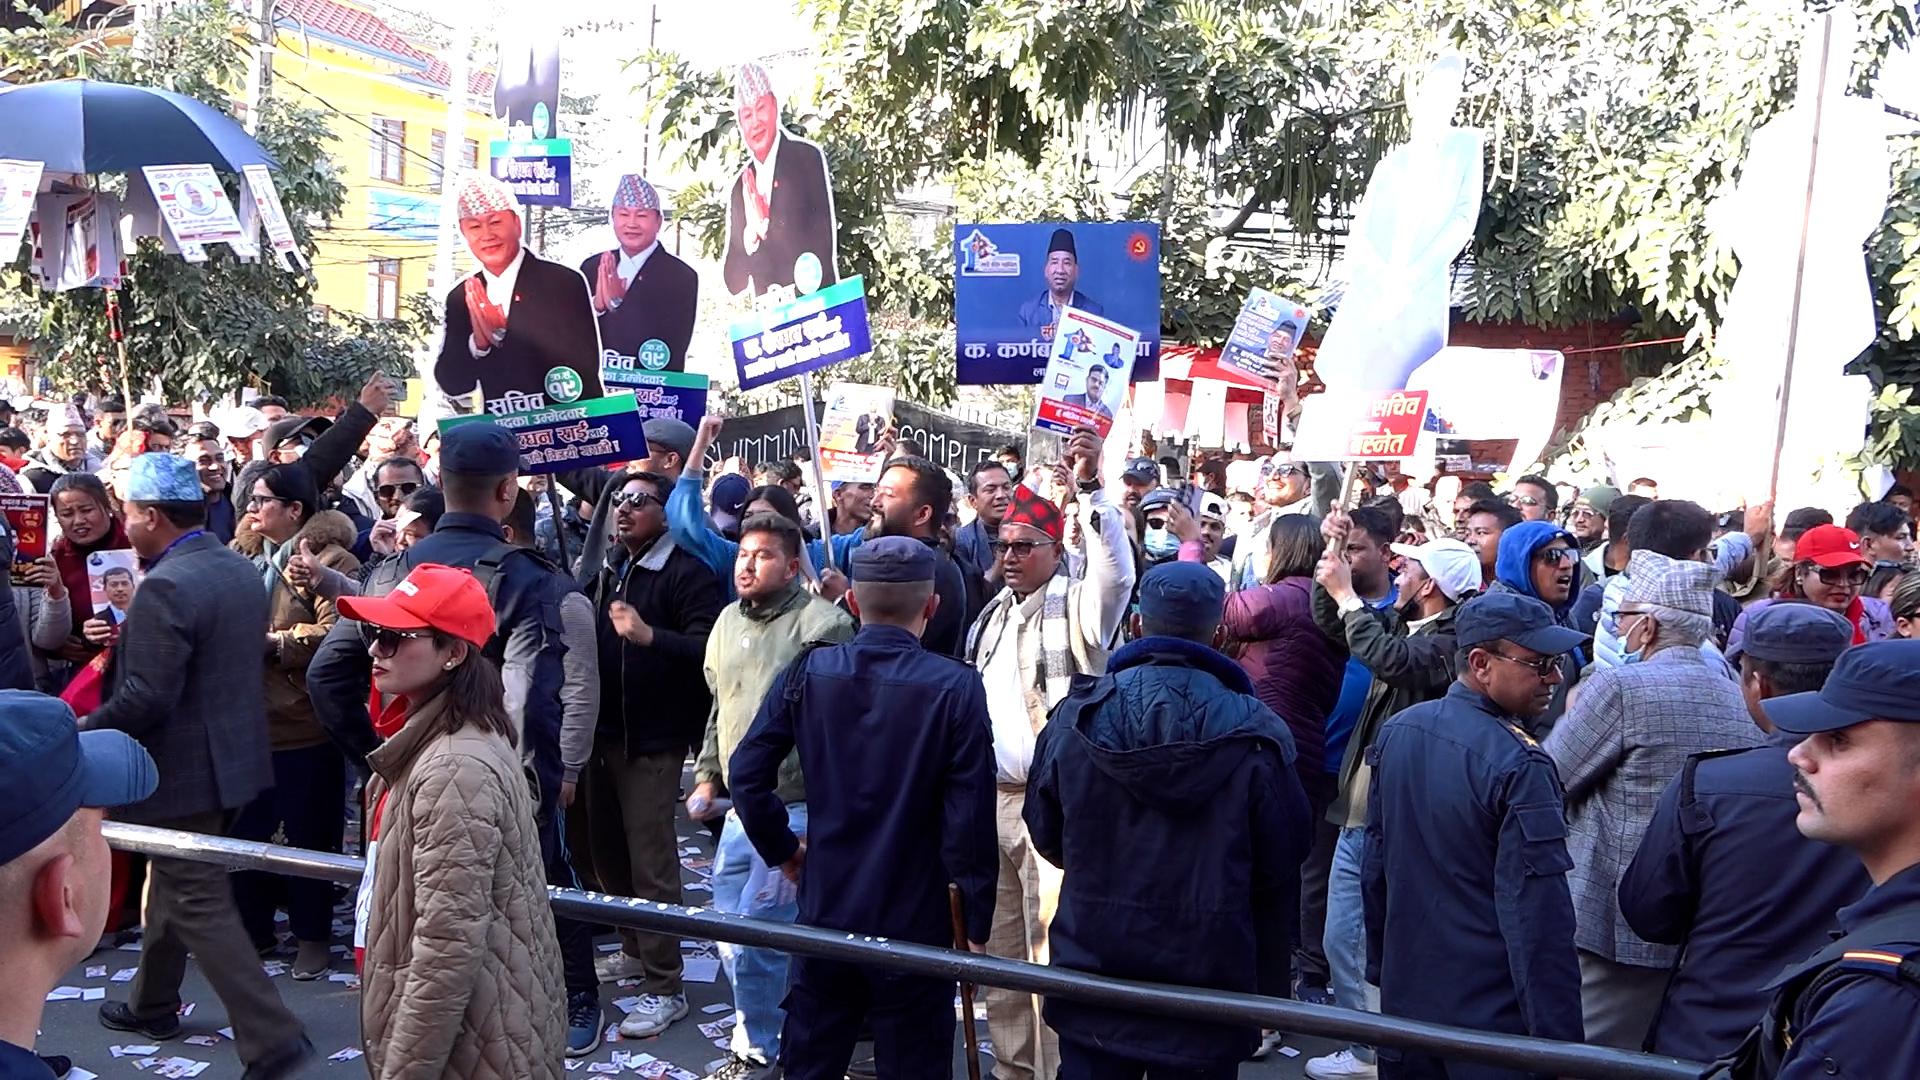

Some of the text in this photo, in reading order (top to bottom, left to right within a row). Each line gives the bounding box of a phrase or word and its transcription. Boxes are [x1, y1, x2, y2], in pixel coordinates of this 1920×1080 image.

[603, 349, 636, 371] चिव
[486, 390, 545, 416] सचिव
[533, 406, 588, 424] उम्मेदवार
[702, 423, 822, 472] SWIMMIN
